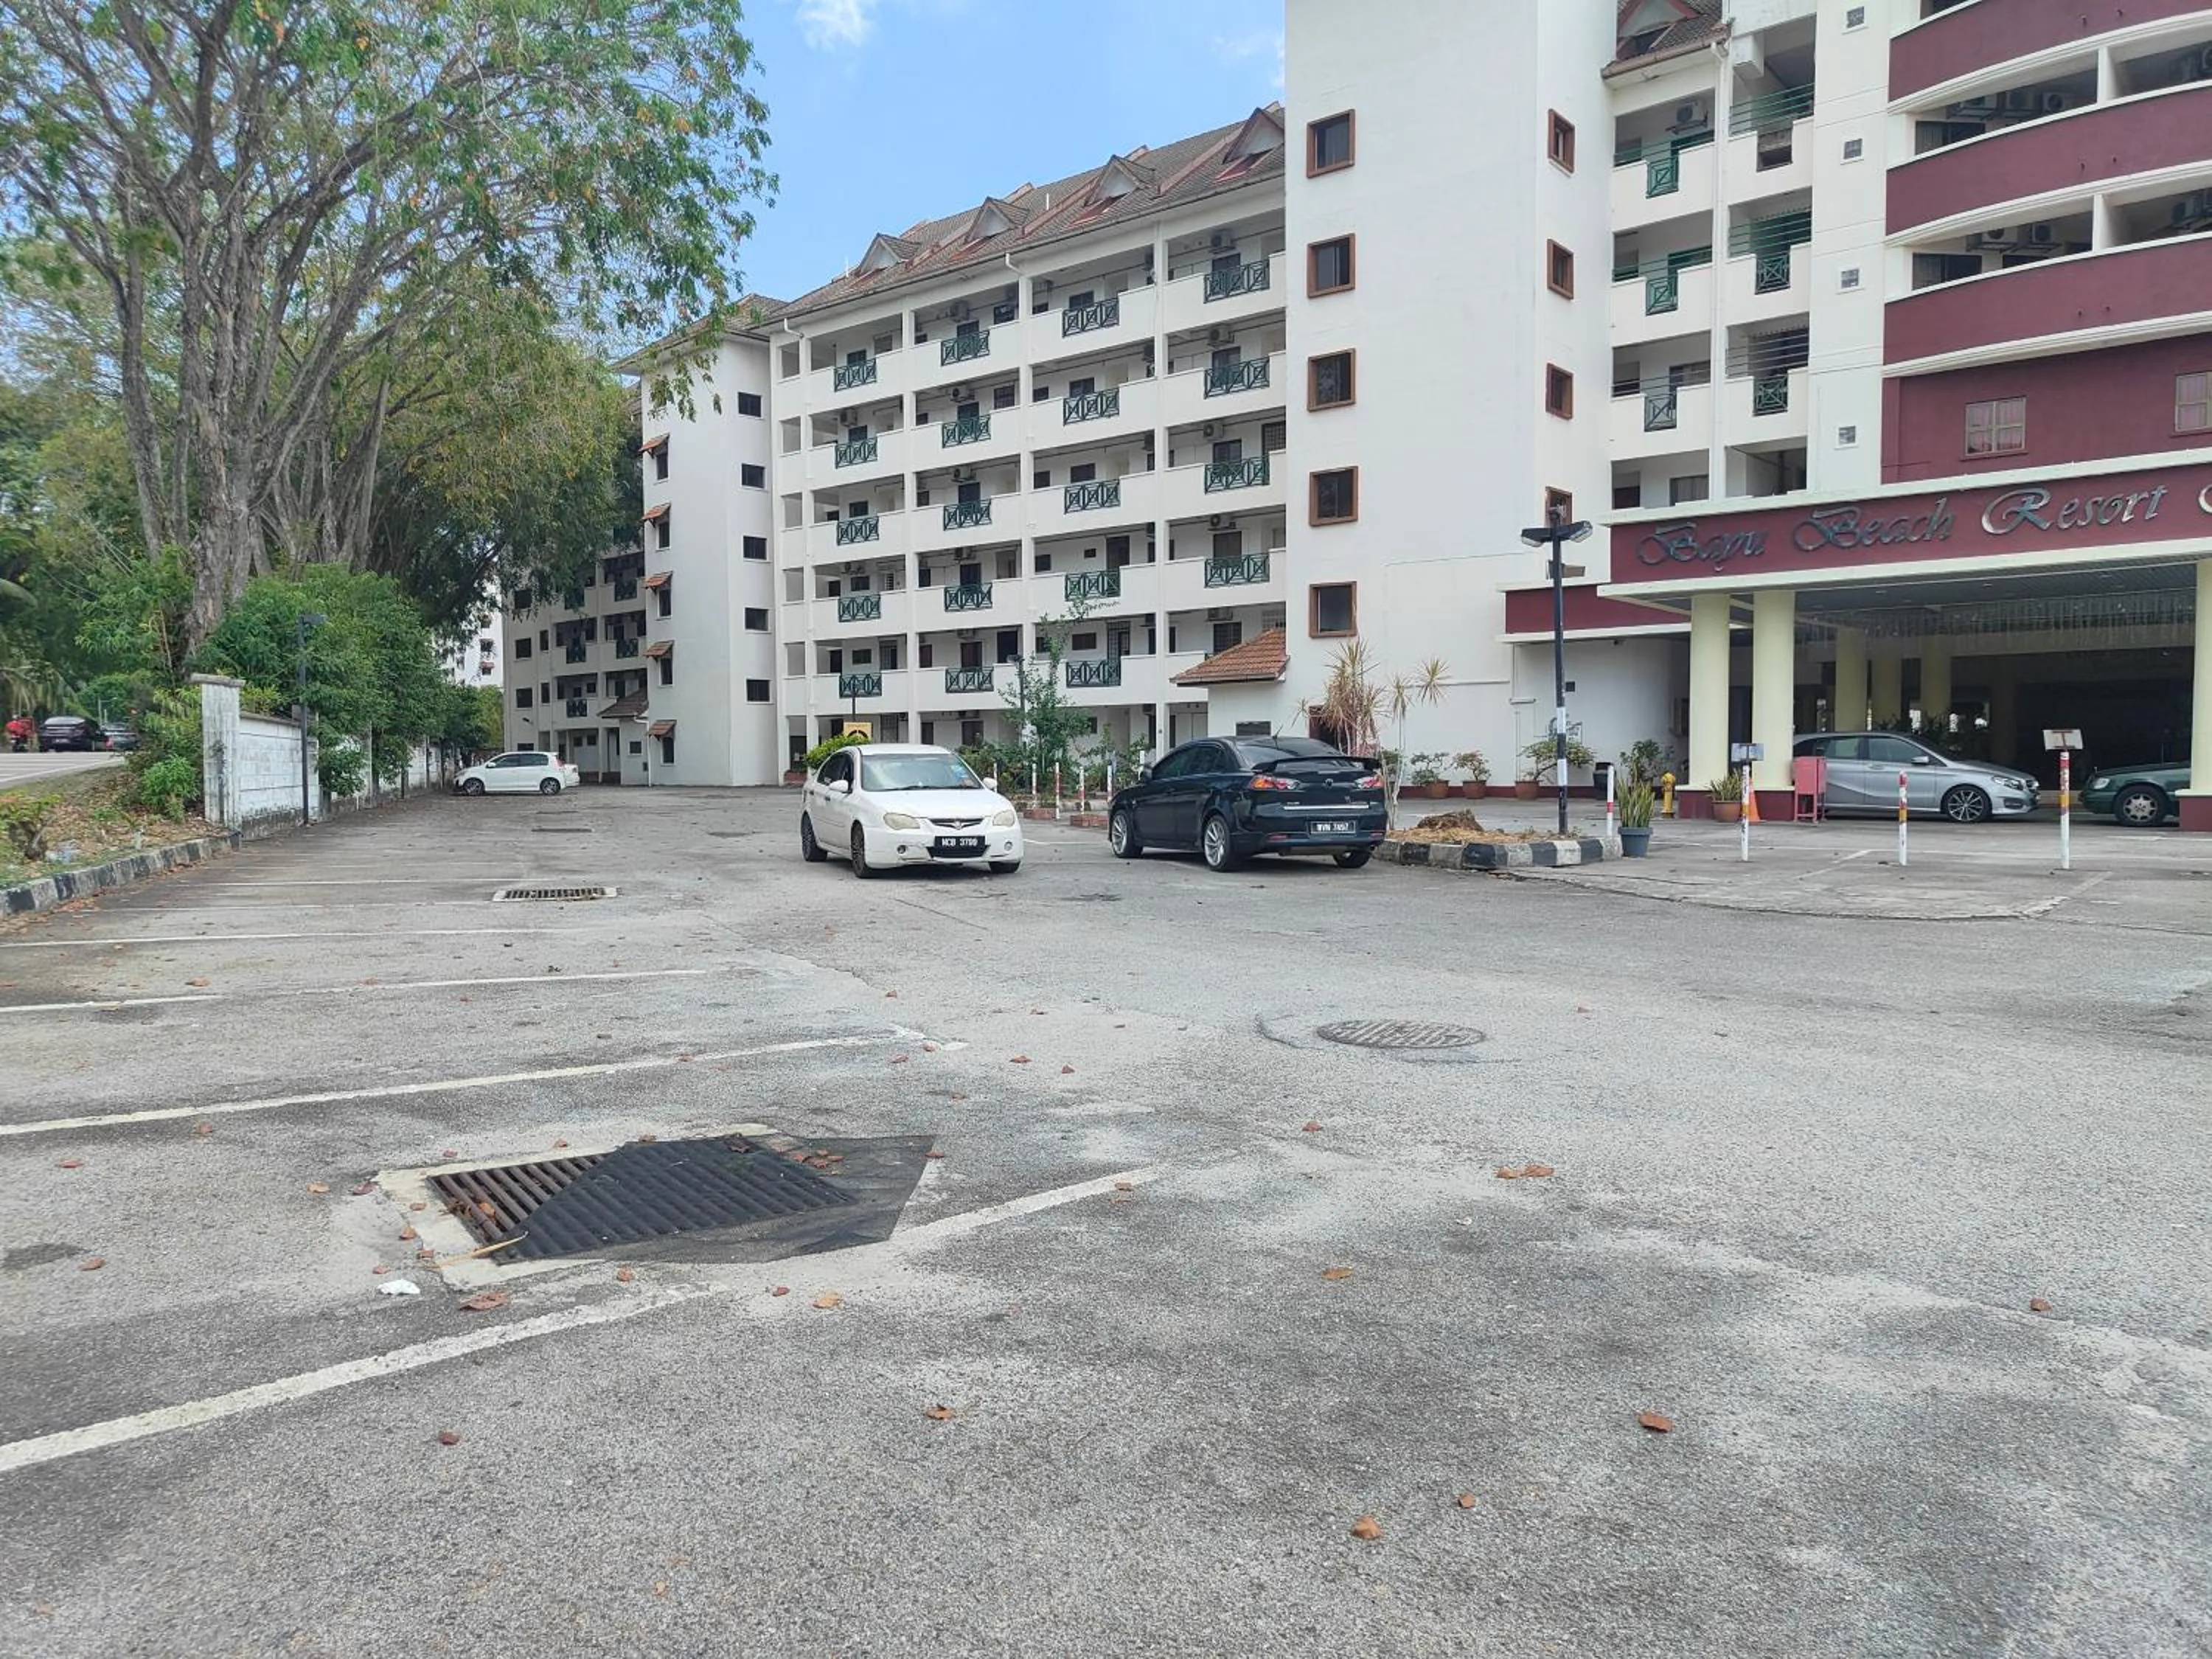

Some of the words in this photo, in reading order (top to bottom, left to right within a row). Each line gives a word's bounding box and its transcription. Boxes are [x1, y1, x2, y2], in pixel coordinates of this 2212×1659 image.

[1637, 521, 1769, 571] Bayu
[1793, 498, 1955, 551] Beach
[1981, 484, 2168, 535] Resort
